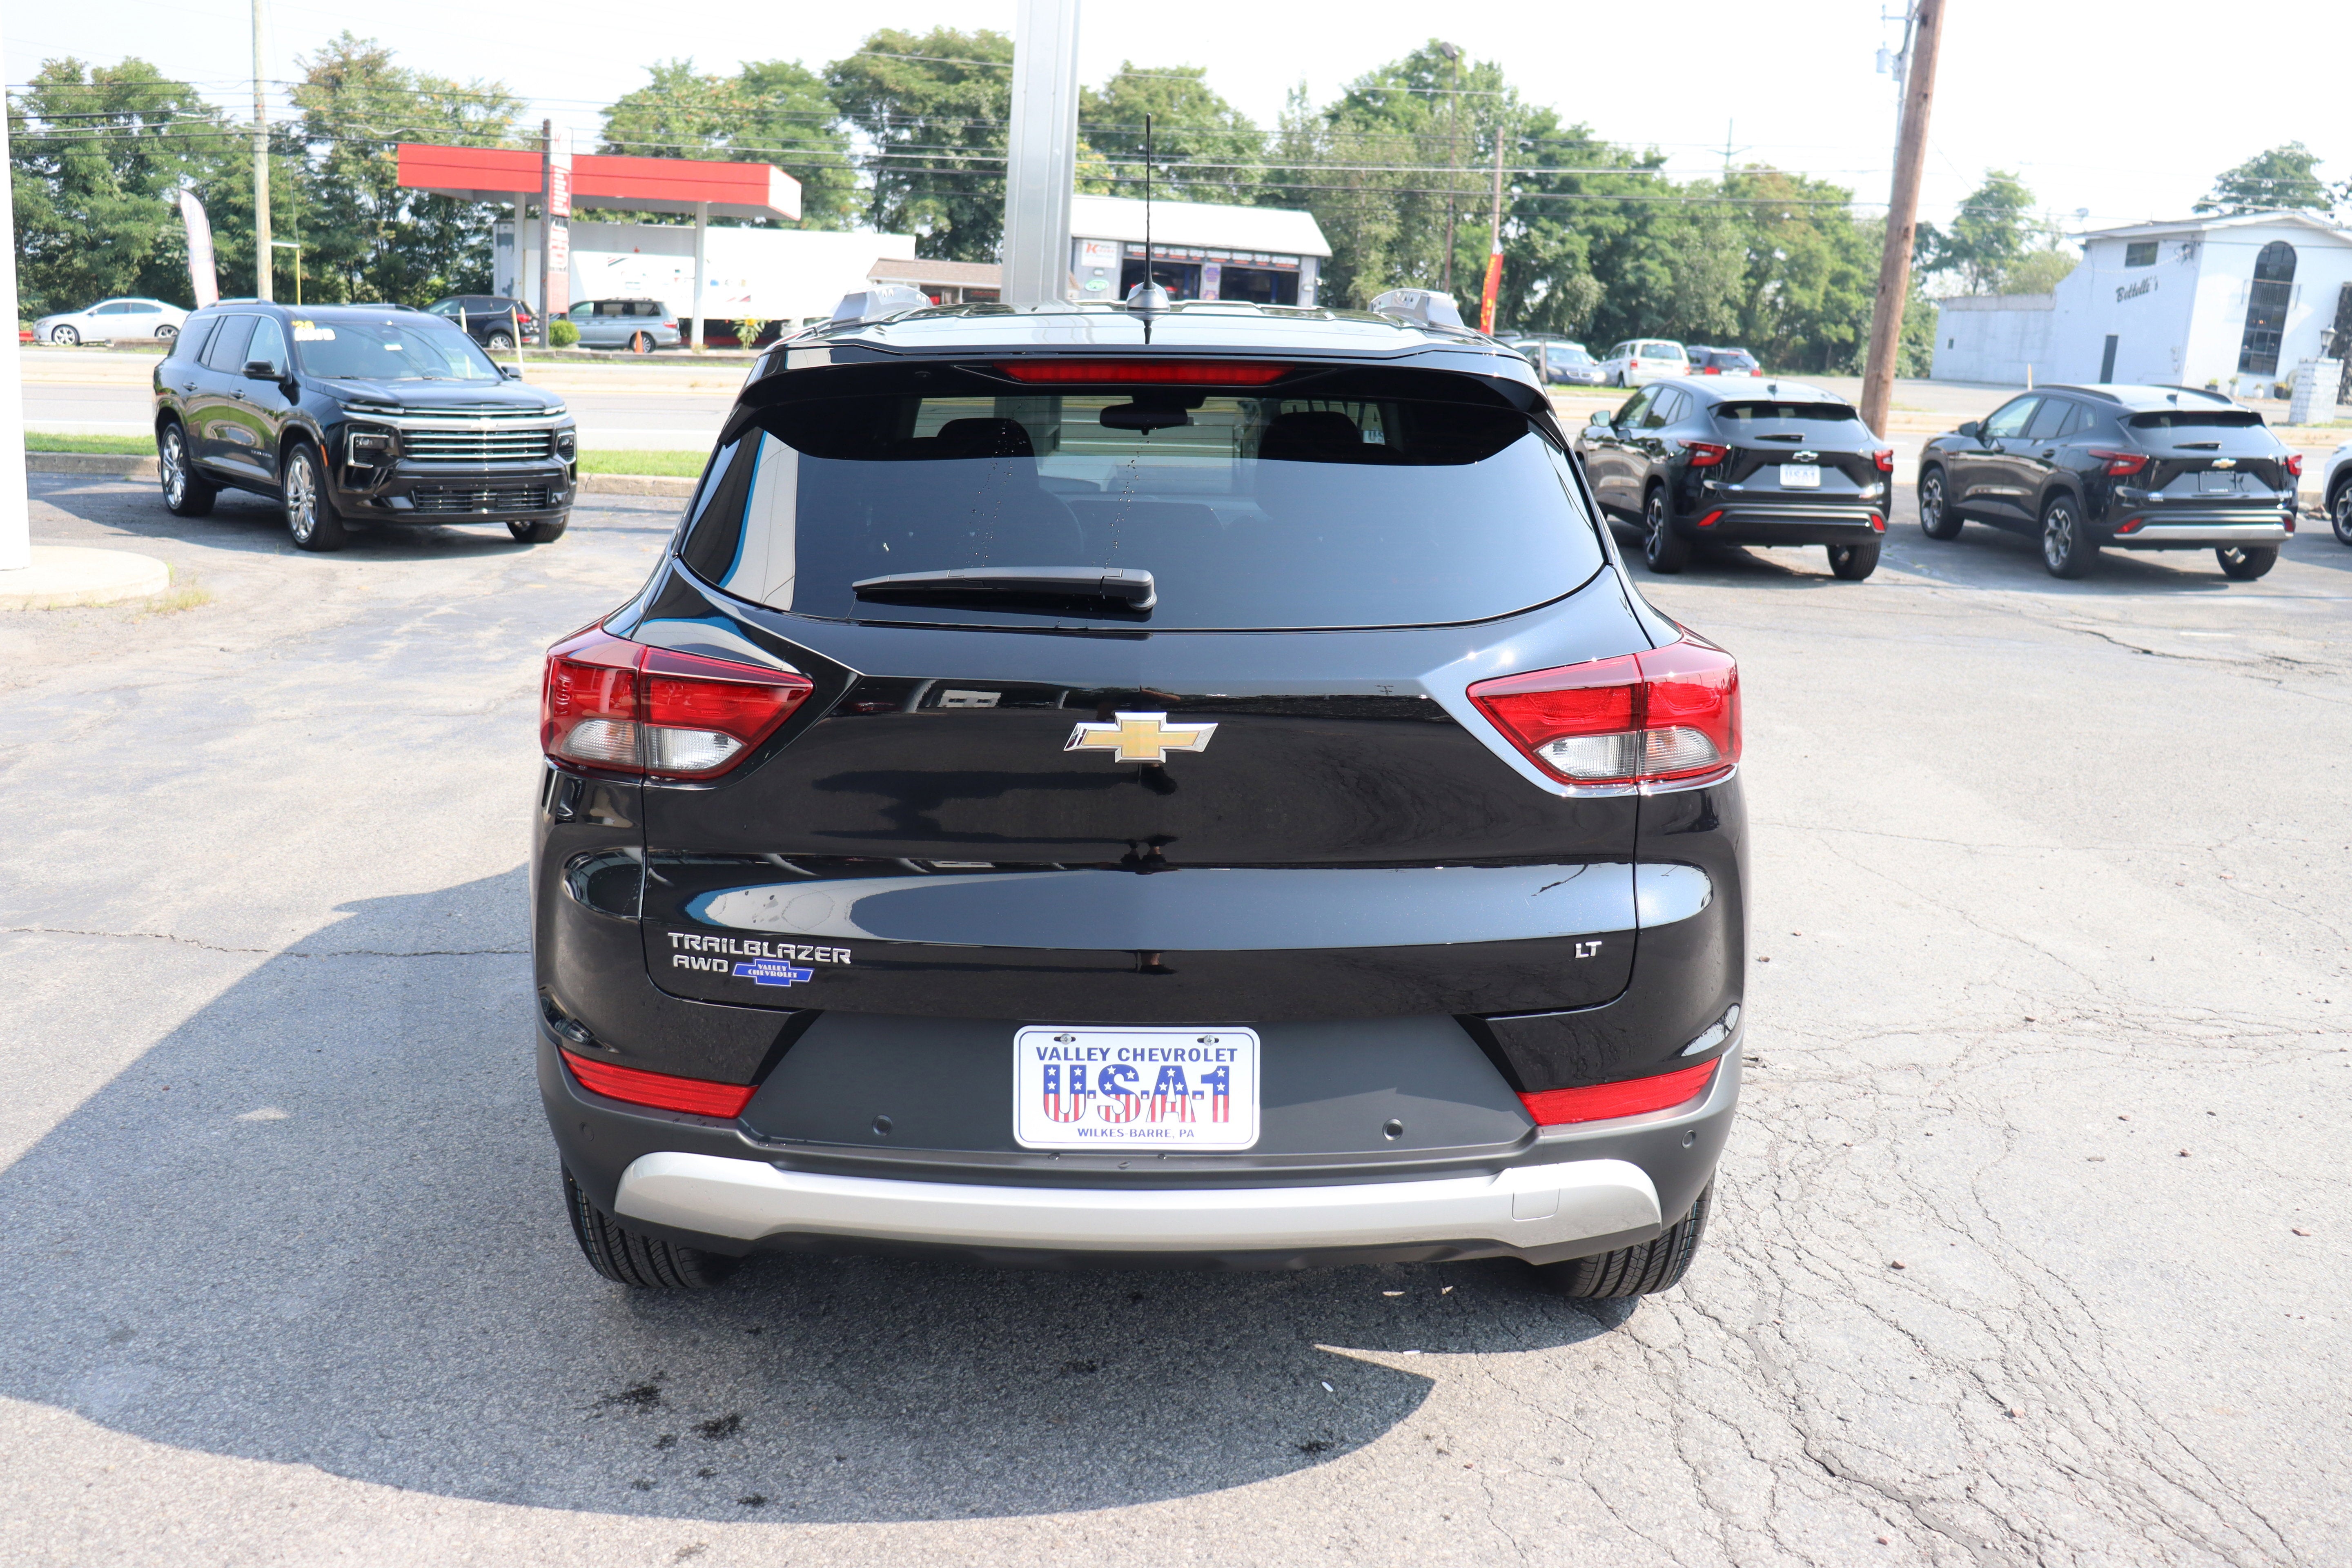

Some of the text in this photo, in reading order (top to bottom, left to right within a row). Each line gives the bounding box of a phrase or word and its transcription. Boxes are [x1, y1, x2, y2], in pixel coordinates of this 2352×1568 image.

[668, 933, 851, 964] TRAILBLAZER
[1575, 941, 1602, 958] LT
[673, 954, 729, 972] AWD
[748, 969, 797, 978] CHEVROLET
[1036, 1047, 1238, 1062] VALLEY CHEVROLET
[1078, 1128, 1194, 1139] WILKES-BARRE, PA
